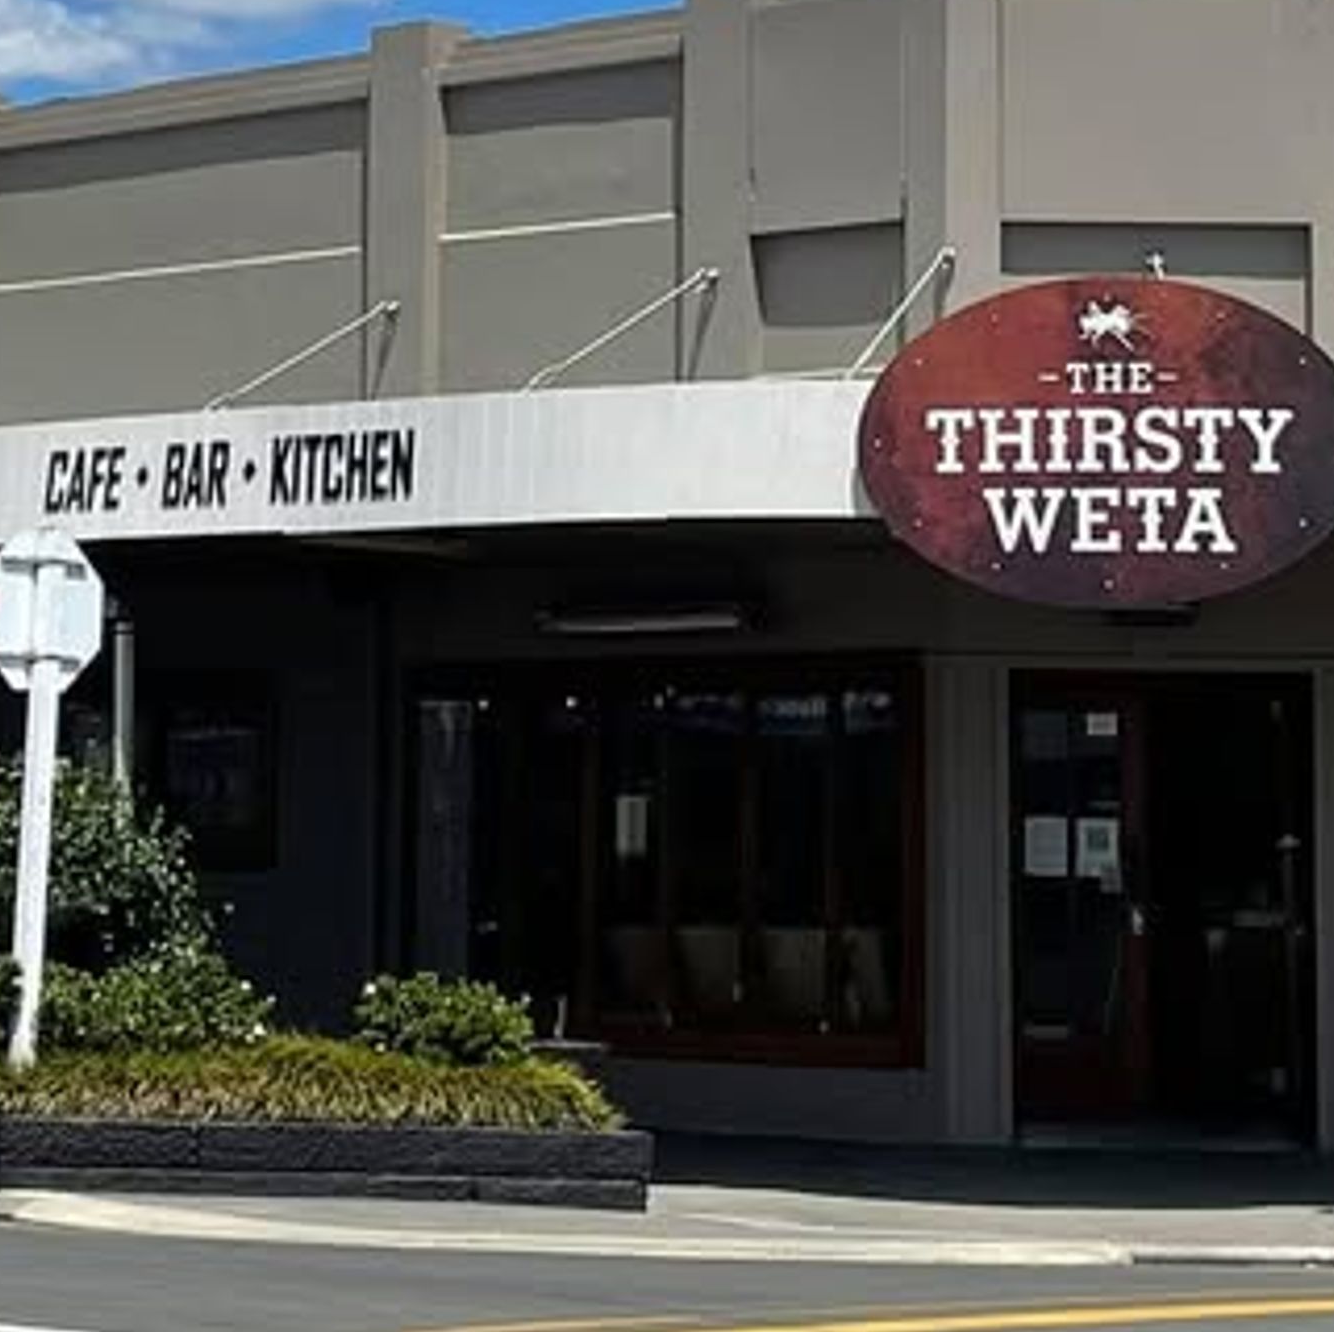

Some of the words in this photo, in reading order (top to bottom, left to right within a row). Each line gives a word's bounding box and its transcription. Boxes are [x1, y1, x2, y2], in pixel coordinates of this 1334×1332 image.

[1066, 363, 1155, 395] THE
[45, 446, 126, 513] CAFE
[162, 441, 230, 509] BAR
[269, 428, 415, 506] KITCHEN
[925, 409, 1293, 473] THIRSTY
[984, 488, 1236, 553] WETA
